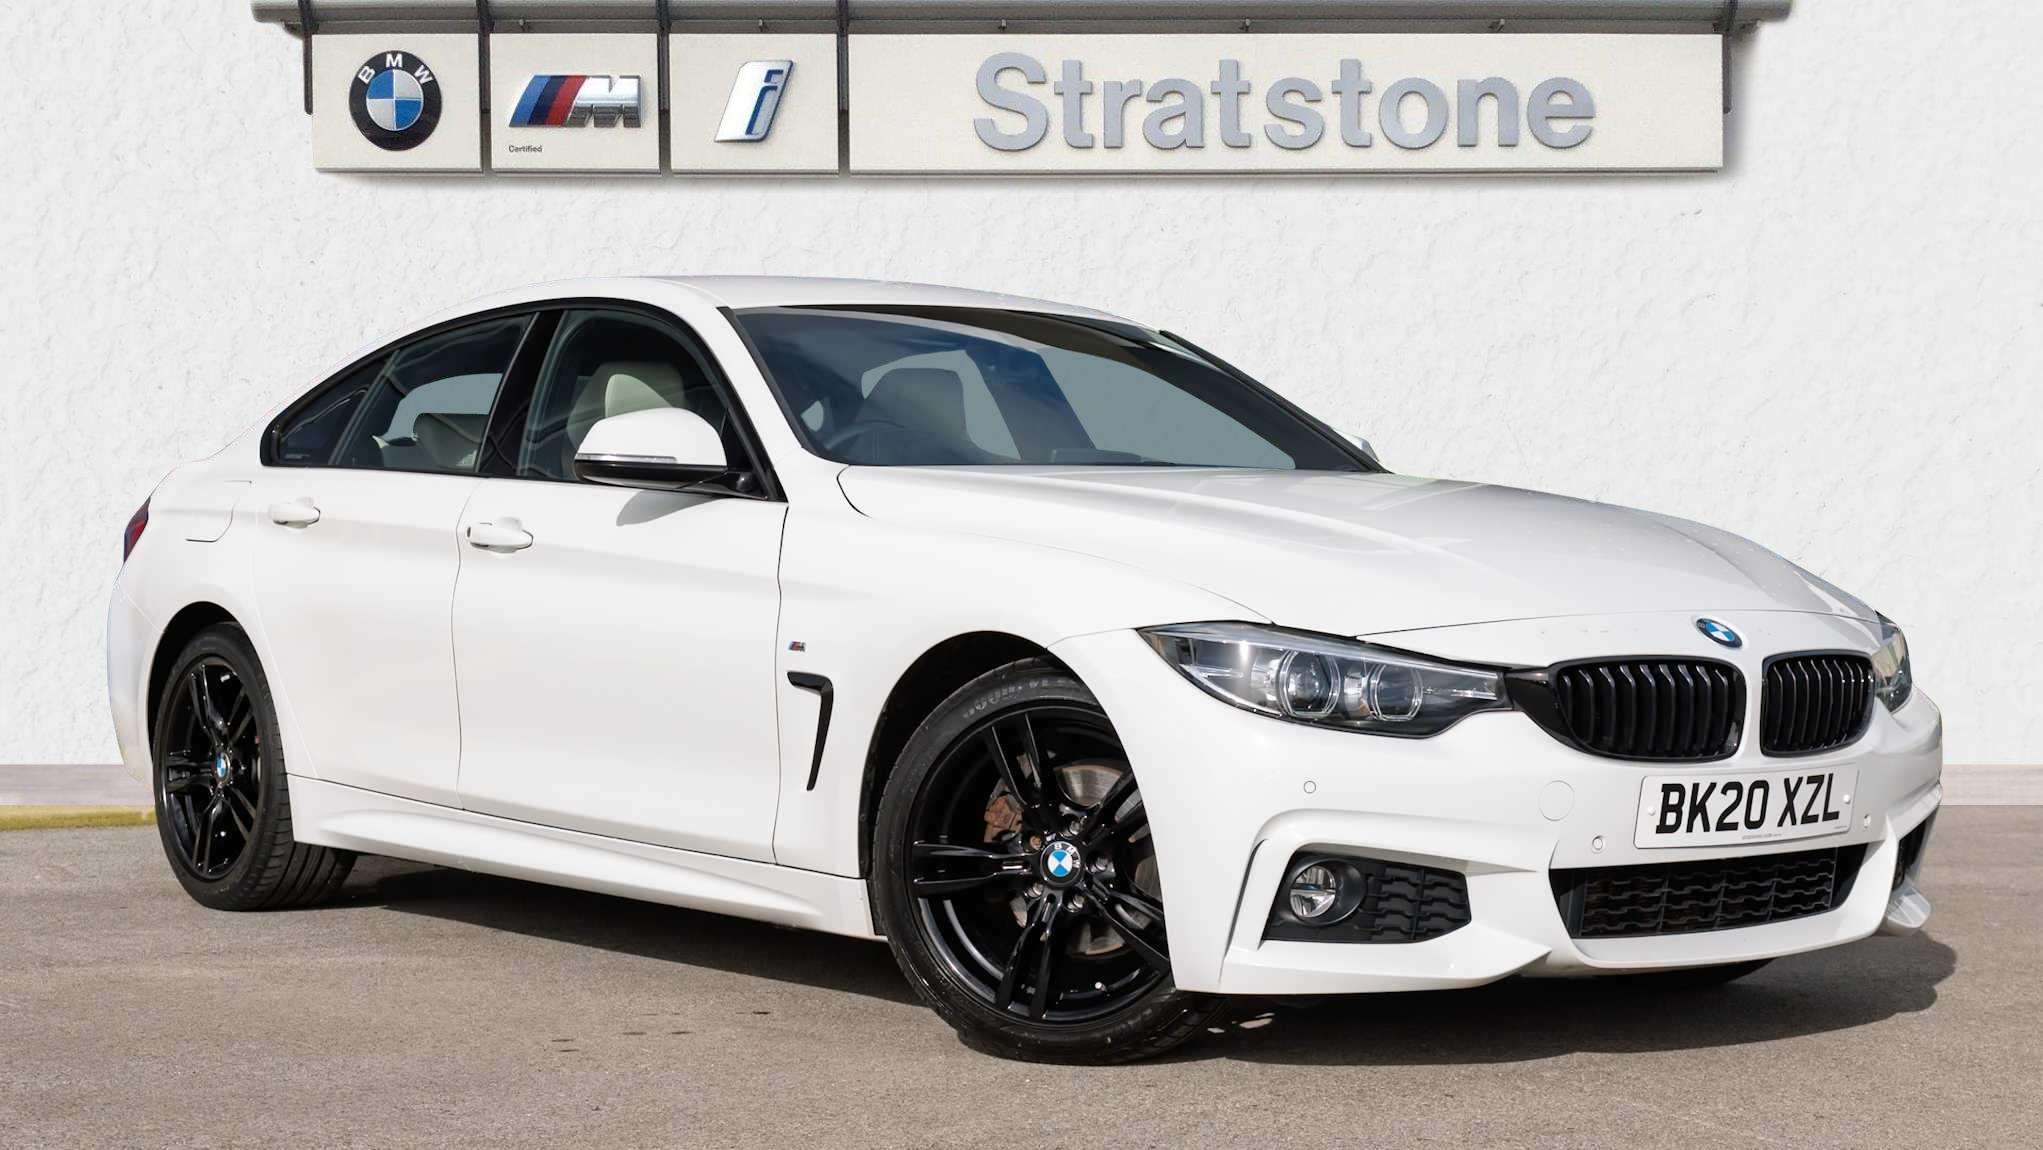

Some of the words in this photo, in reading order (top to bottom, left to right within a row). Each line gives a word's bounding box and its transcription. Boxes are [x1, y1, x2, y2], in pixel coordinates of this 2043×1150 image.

[358, 53, 433, 84] BMW
[973, 52, 1597, 151] Stratstone
[508, 144, 543, 153] Certified
[1655, 780, 1770, 834] BK20
[1777, 772, 1840, 827] XZL
